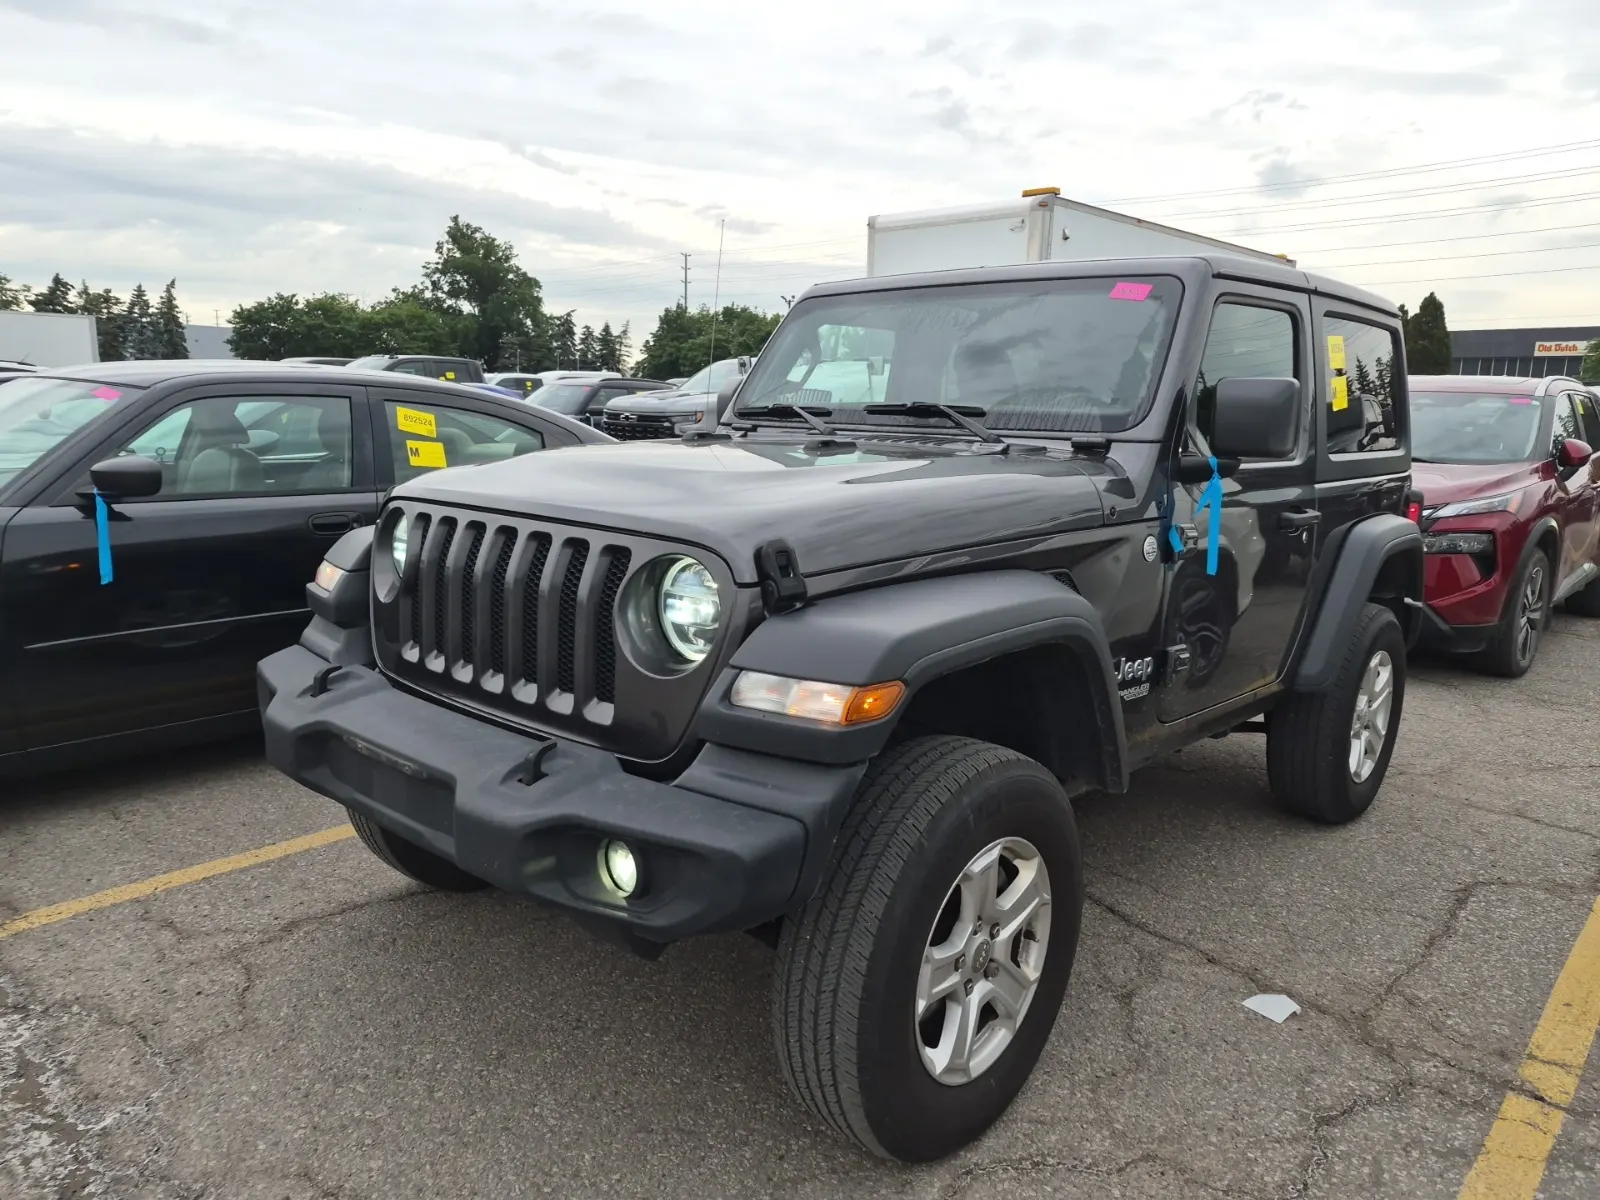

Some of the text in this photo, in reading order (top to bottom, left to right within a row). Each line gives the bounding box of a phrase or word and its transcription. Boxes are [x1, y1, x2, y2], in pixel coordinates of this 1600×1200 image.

[1538, 344, 1578, 352] Old Dutch
[403, 413, 433, 427] 892524
[409, 446, 420, 458] M
[1115, 656, 1154, 681] Jeep
